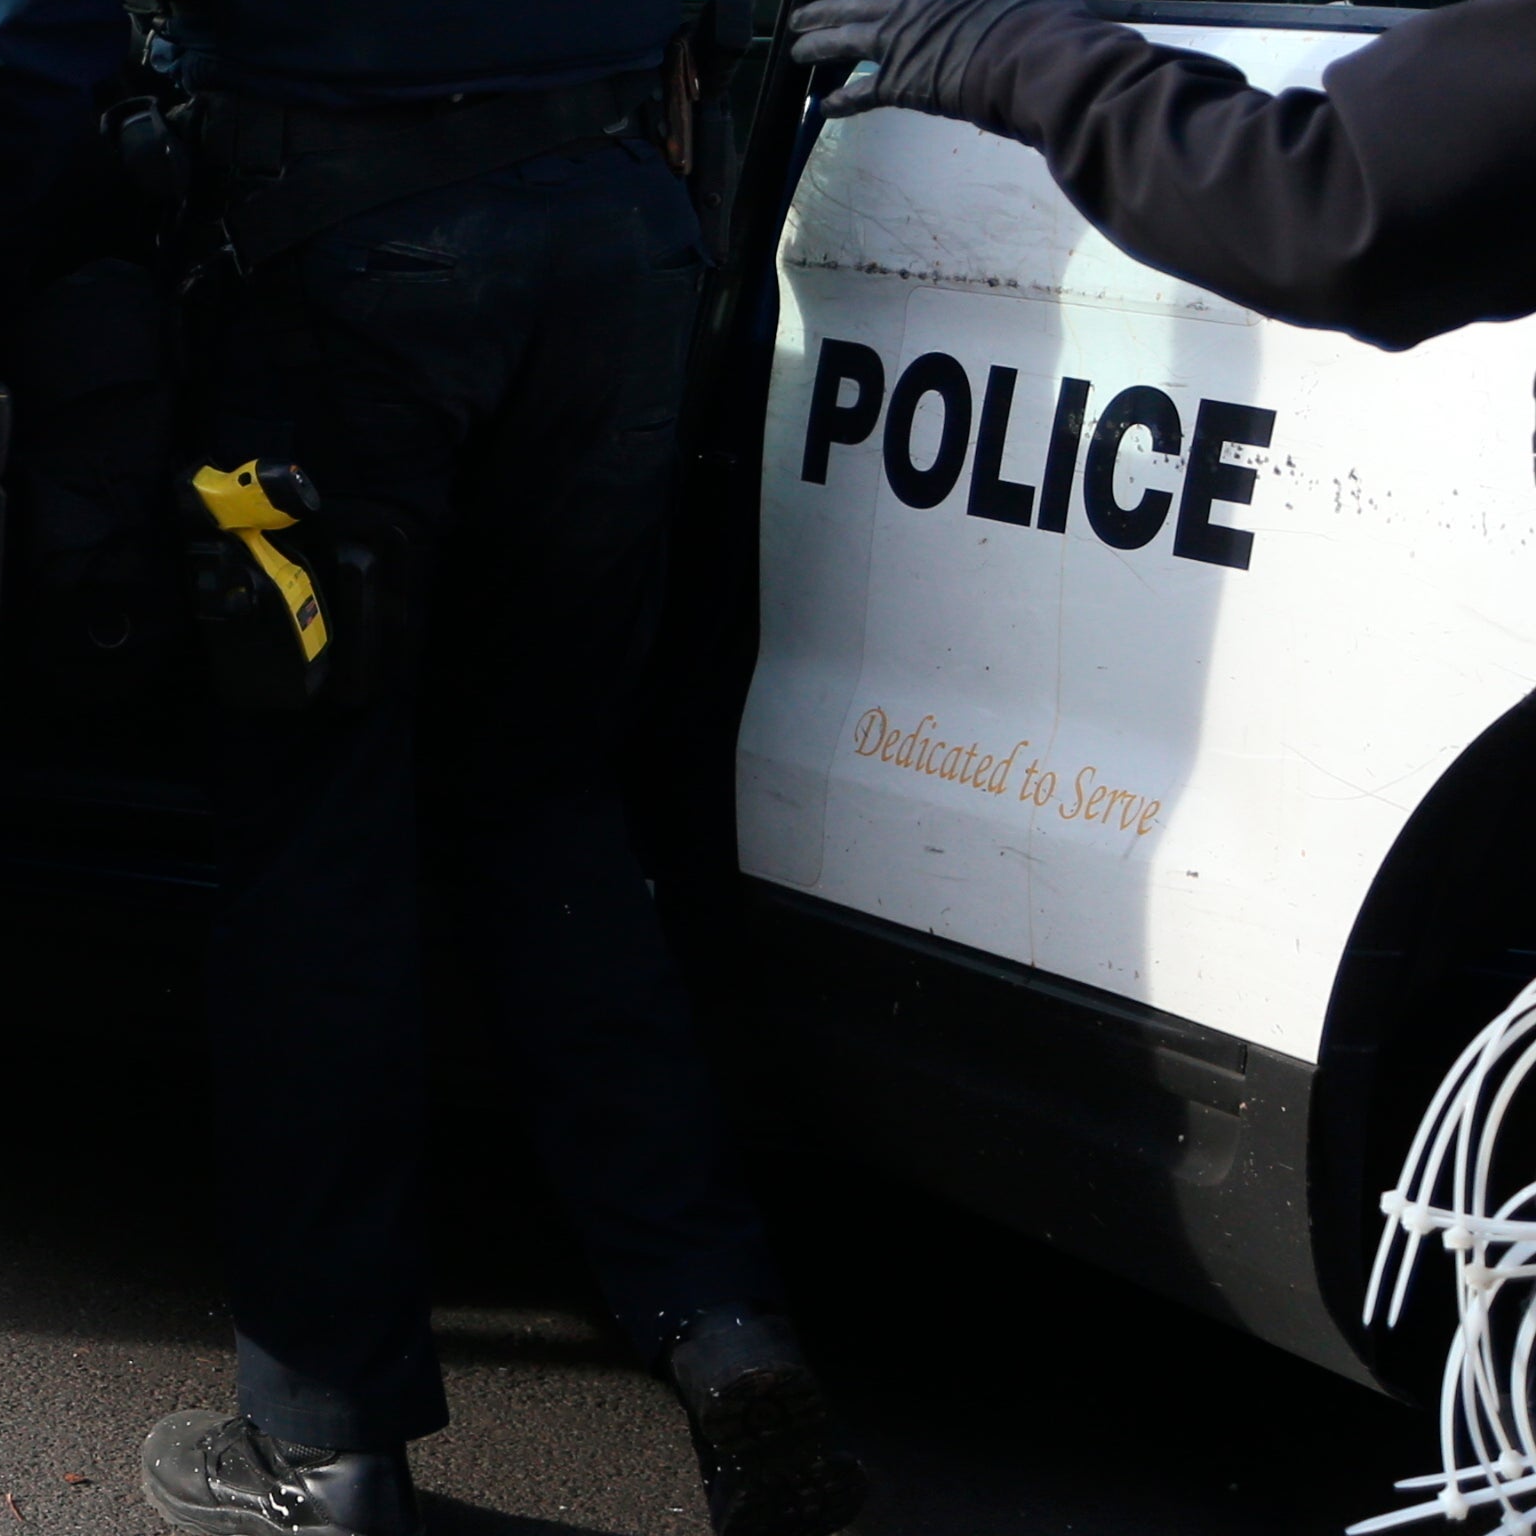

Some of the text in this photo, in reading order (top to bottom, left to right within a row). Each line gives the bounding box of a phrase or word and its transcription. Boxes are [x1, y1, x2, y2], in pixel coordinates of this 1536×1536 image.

[800, 336, 1278, 572] POLICE
[853, 707, 1161, 836] Dedicated to Serve
